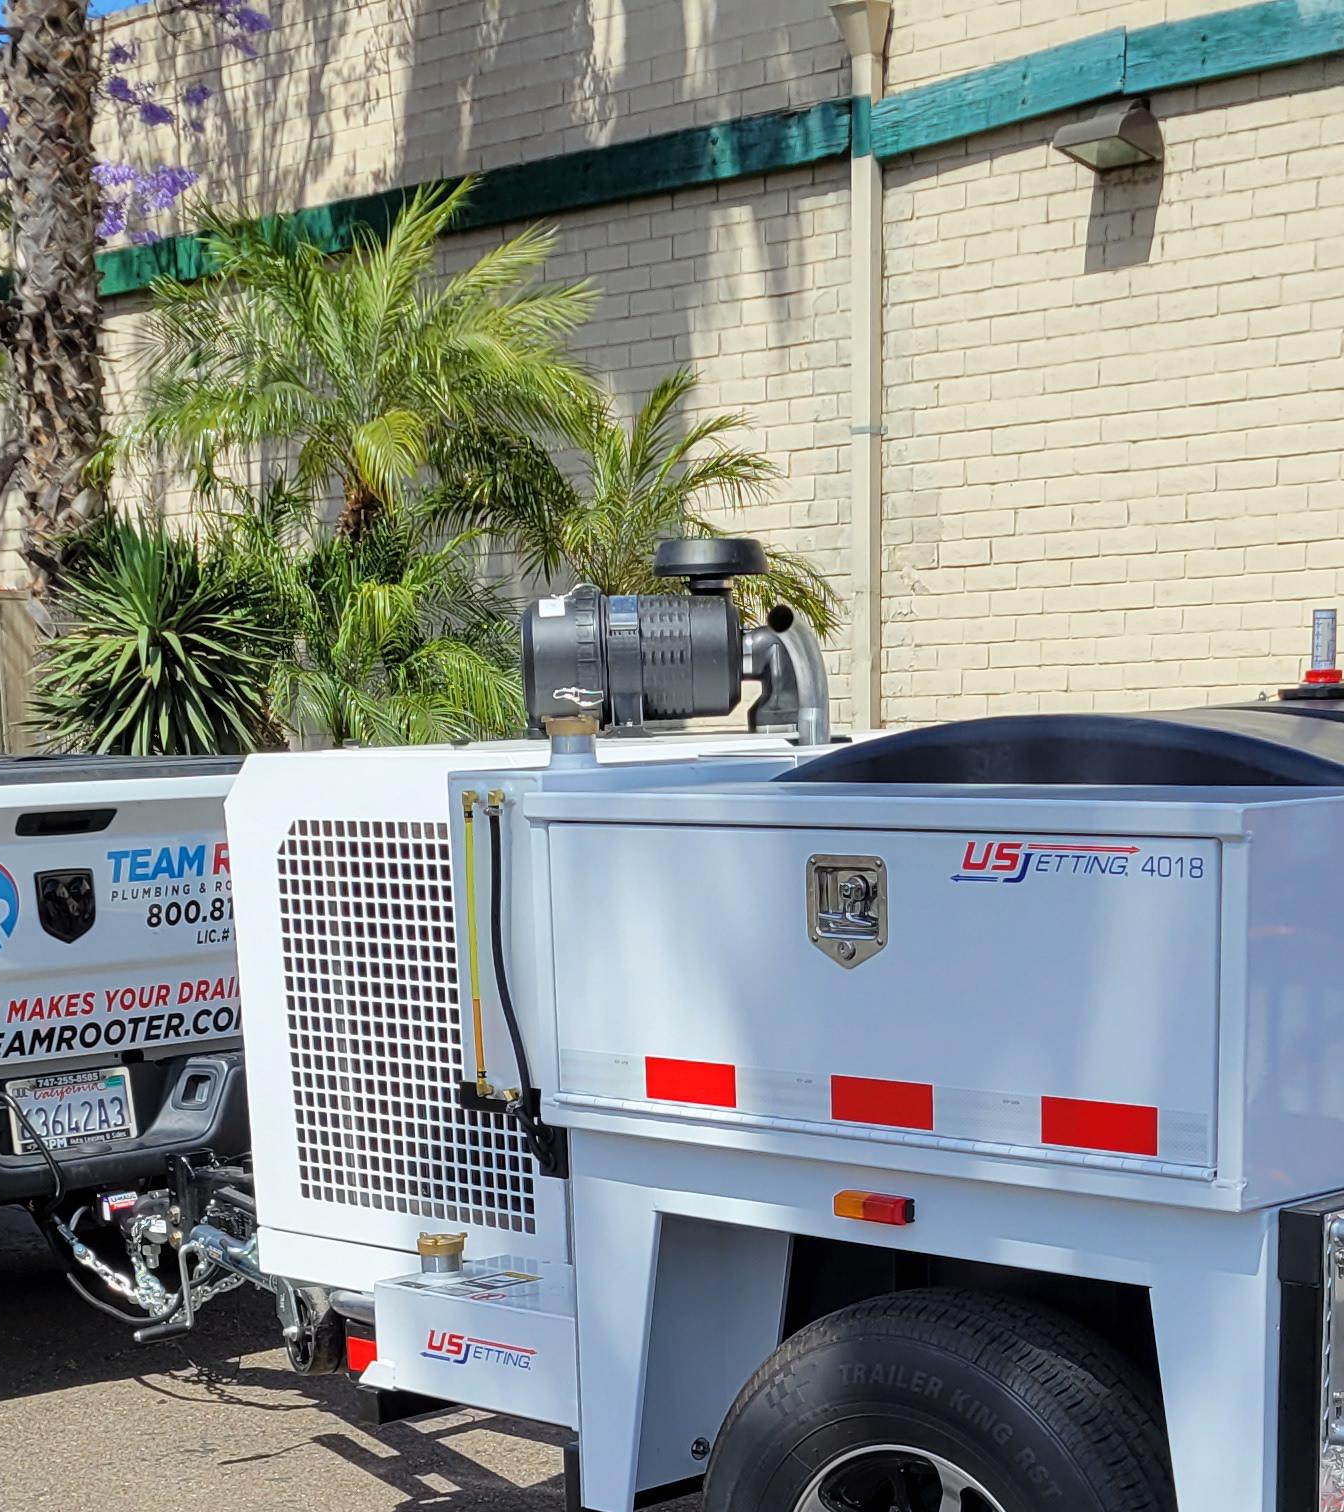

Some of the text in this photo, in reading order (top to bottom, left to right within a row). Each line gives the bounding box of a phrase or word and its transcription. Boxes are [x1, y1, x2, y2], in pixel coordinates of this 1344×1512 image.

[107, 845, 206, 883] TEAM
[1141, 856, 1204, 879] 4018
[111, 884, 191, 902] PLUMBING
[199, 882, 206, 893] &
[196, 928, 230, 944] LIC.#
[7, 992, 96, 1024] MAKES
[105, 984, 171, 1013] YOUR
[177, 976, 241, 1005] DRAI
[34, 1082, 98, 1101] California
[840, 1363, 1063, 1500] TRAILER KING RST
